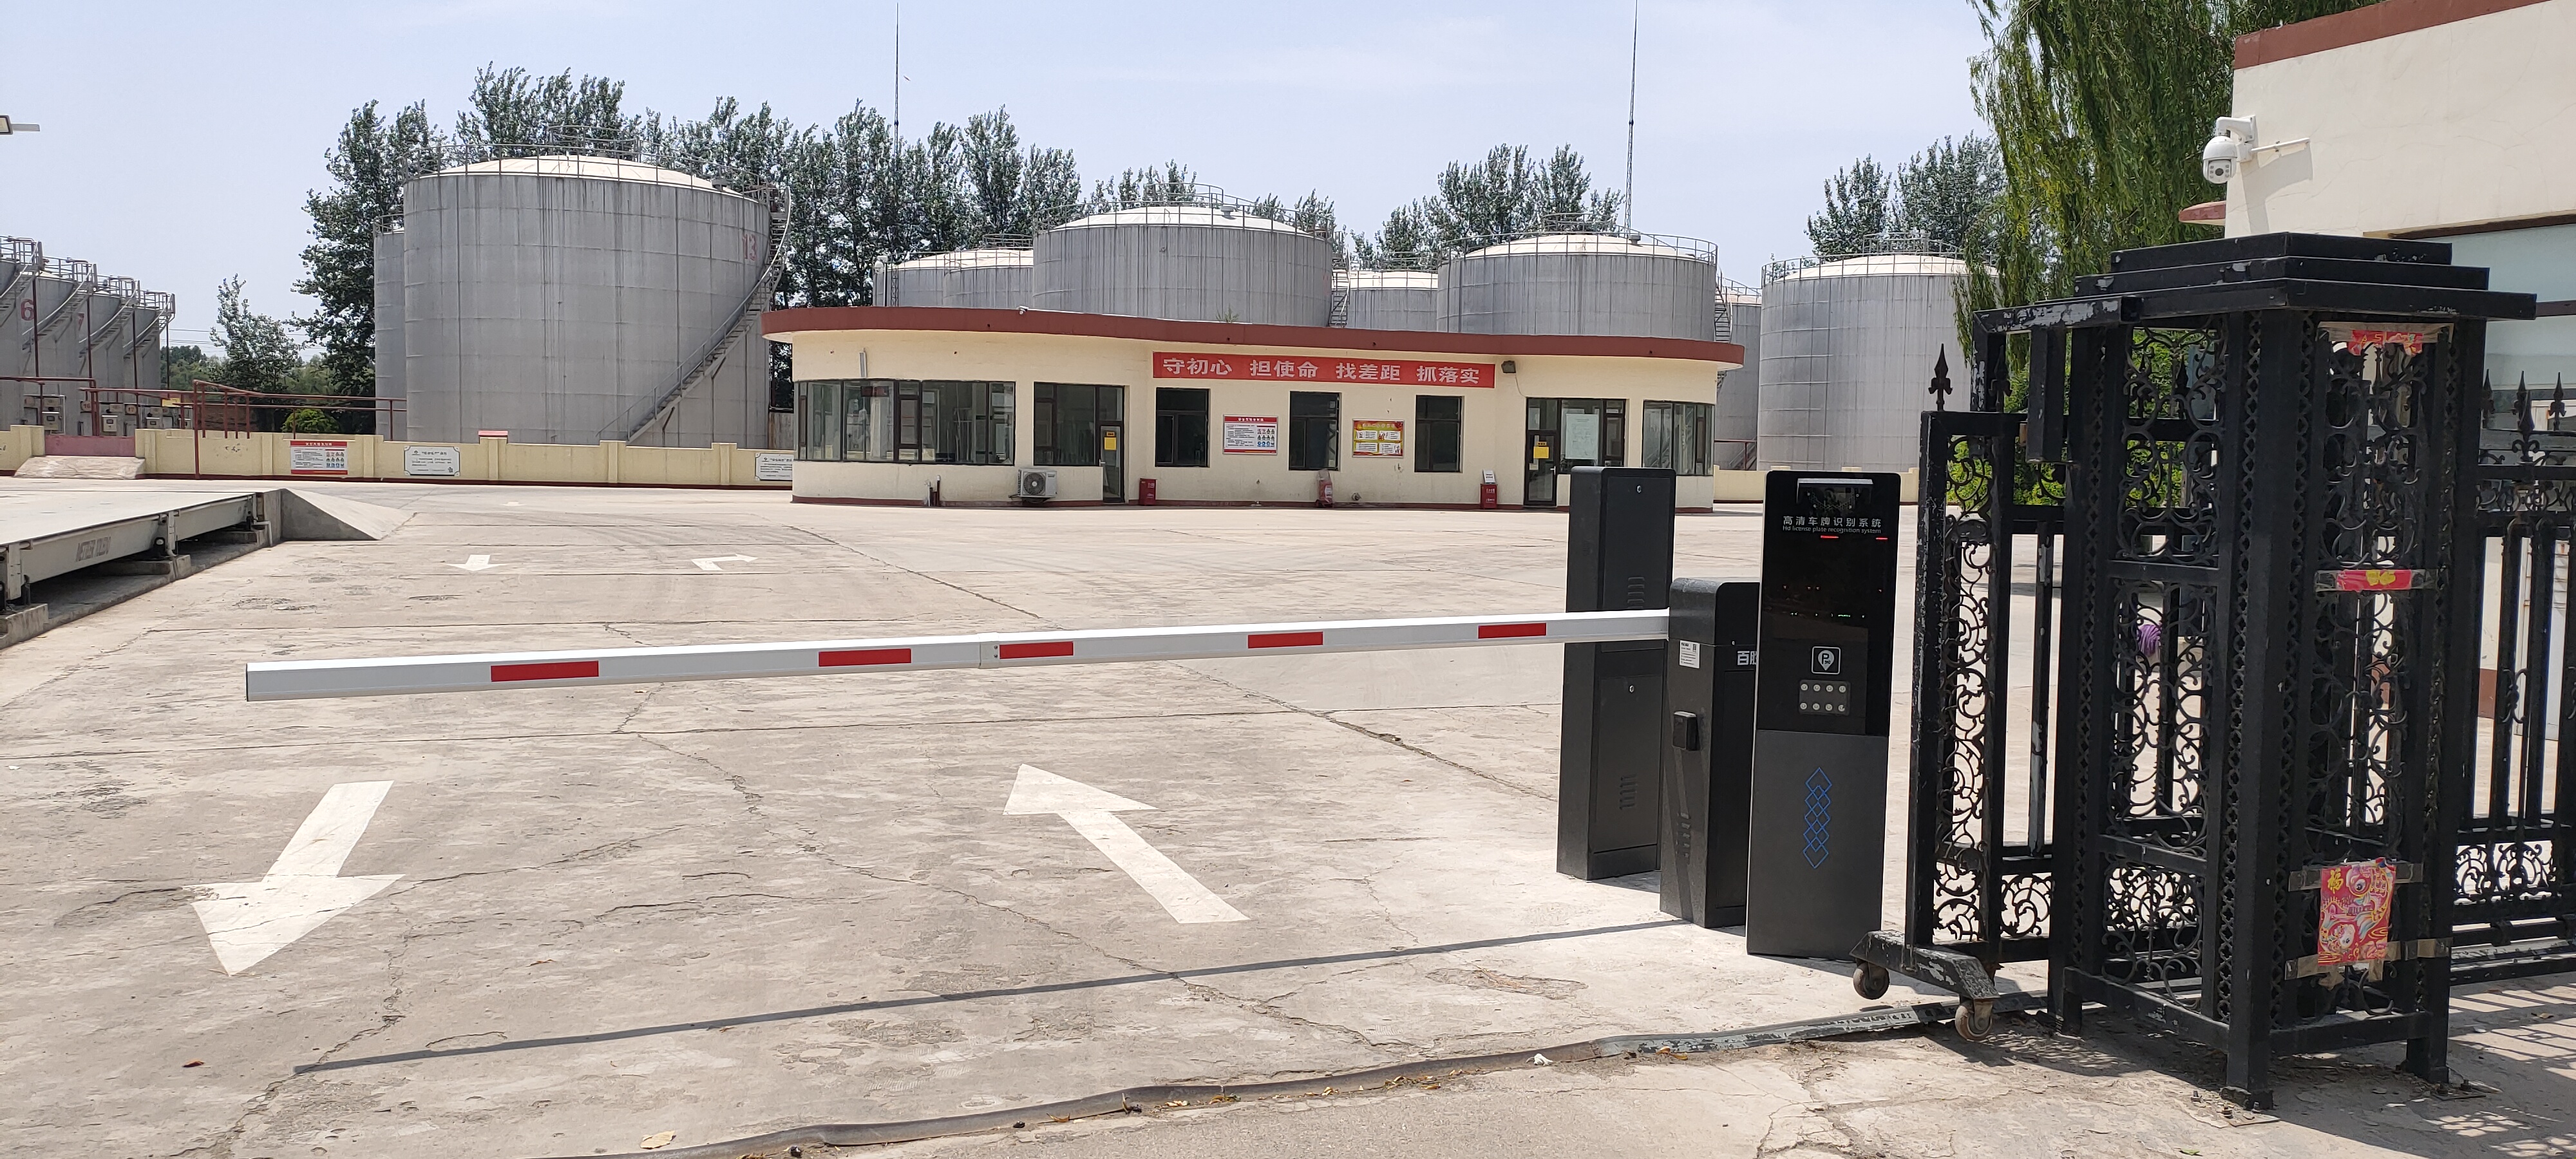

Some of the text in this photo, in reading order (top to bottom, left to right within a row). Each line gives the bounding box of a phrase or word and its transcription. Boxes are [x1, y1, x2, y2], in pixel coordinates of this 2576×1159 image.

[742, 234, 757, 261] 13
[21, 299, 34, 321] 6
[1163, 358, 1480, 384] 守初心 担使命 找差距 抓落实
[1783, 516, 1881, 527] 高清车牌识别系统
[2327, 868, 2344, 894] 福
